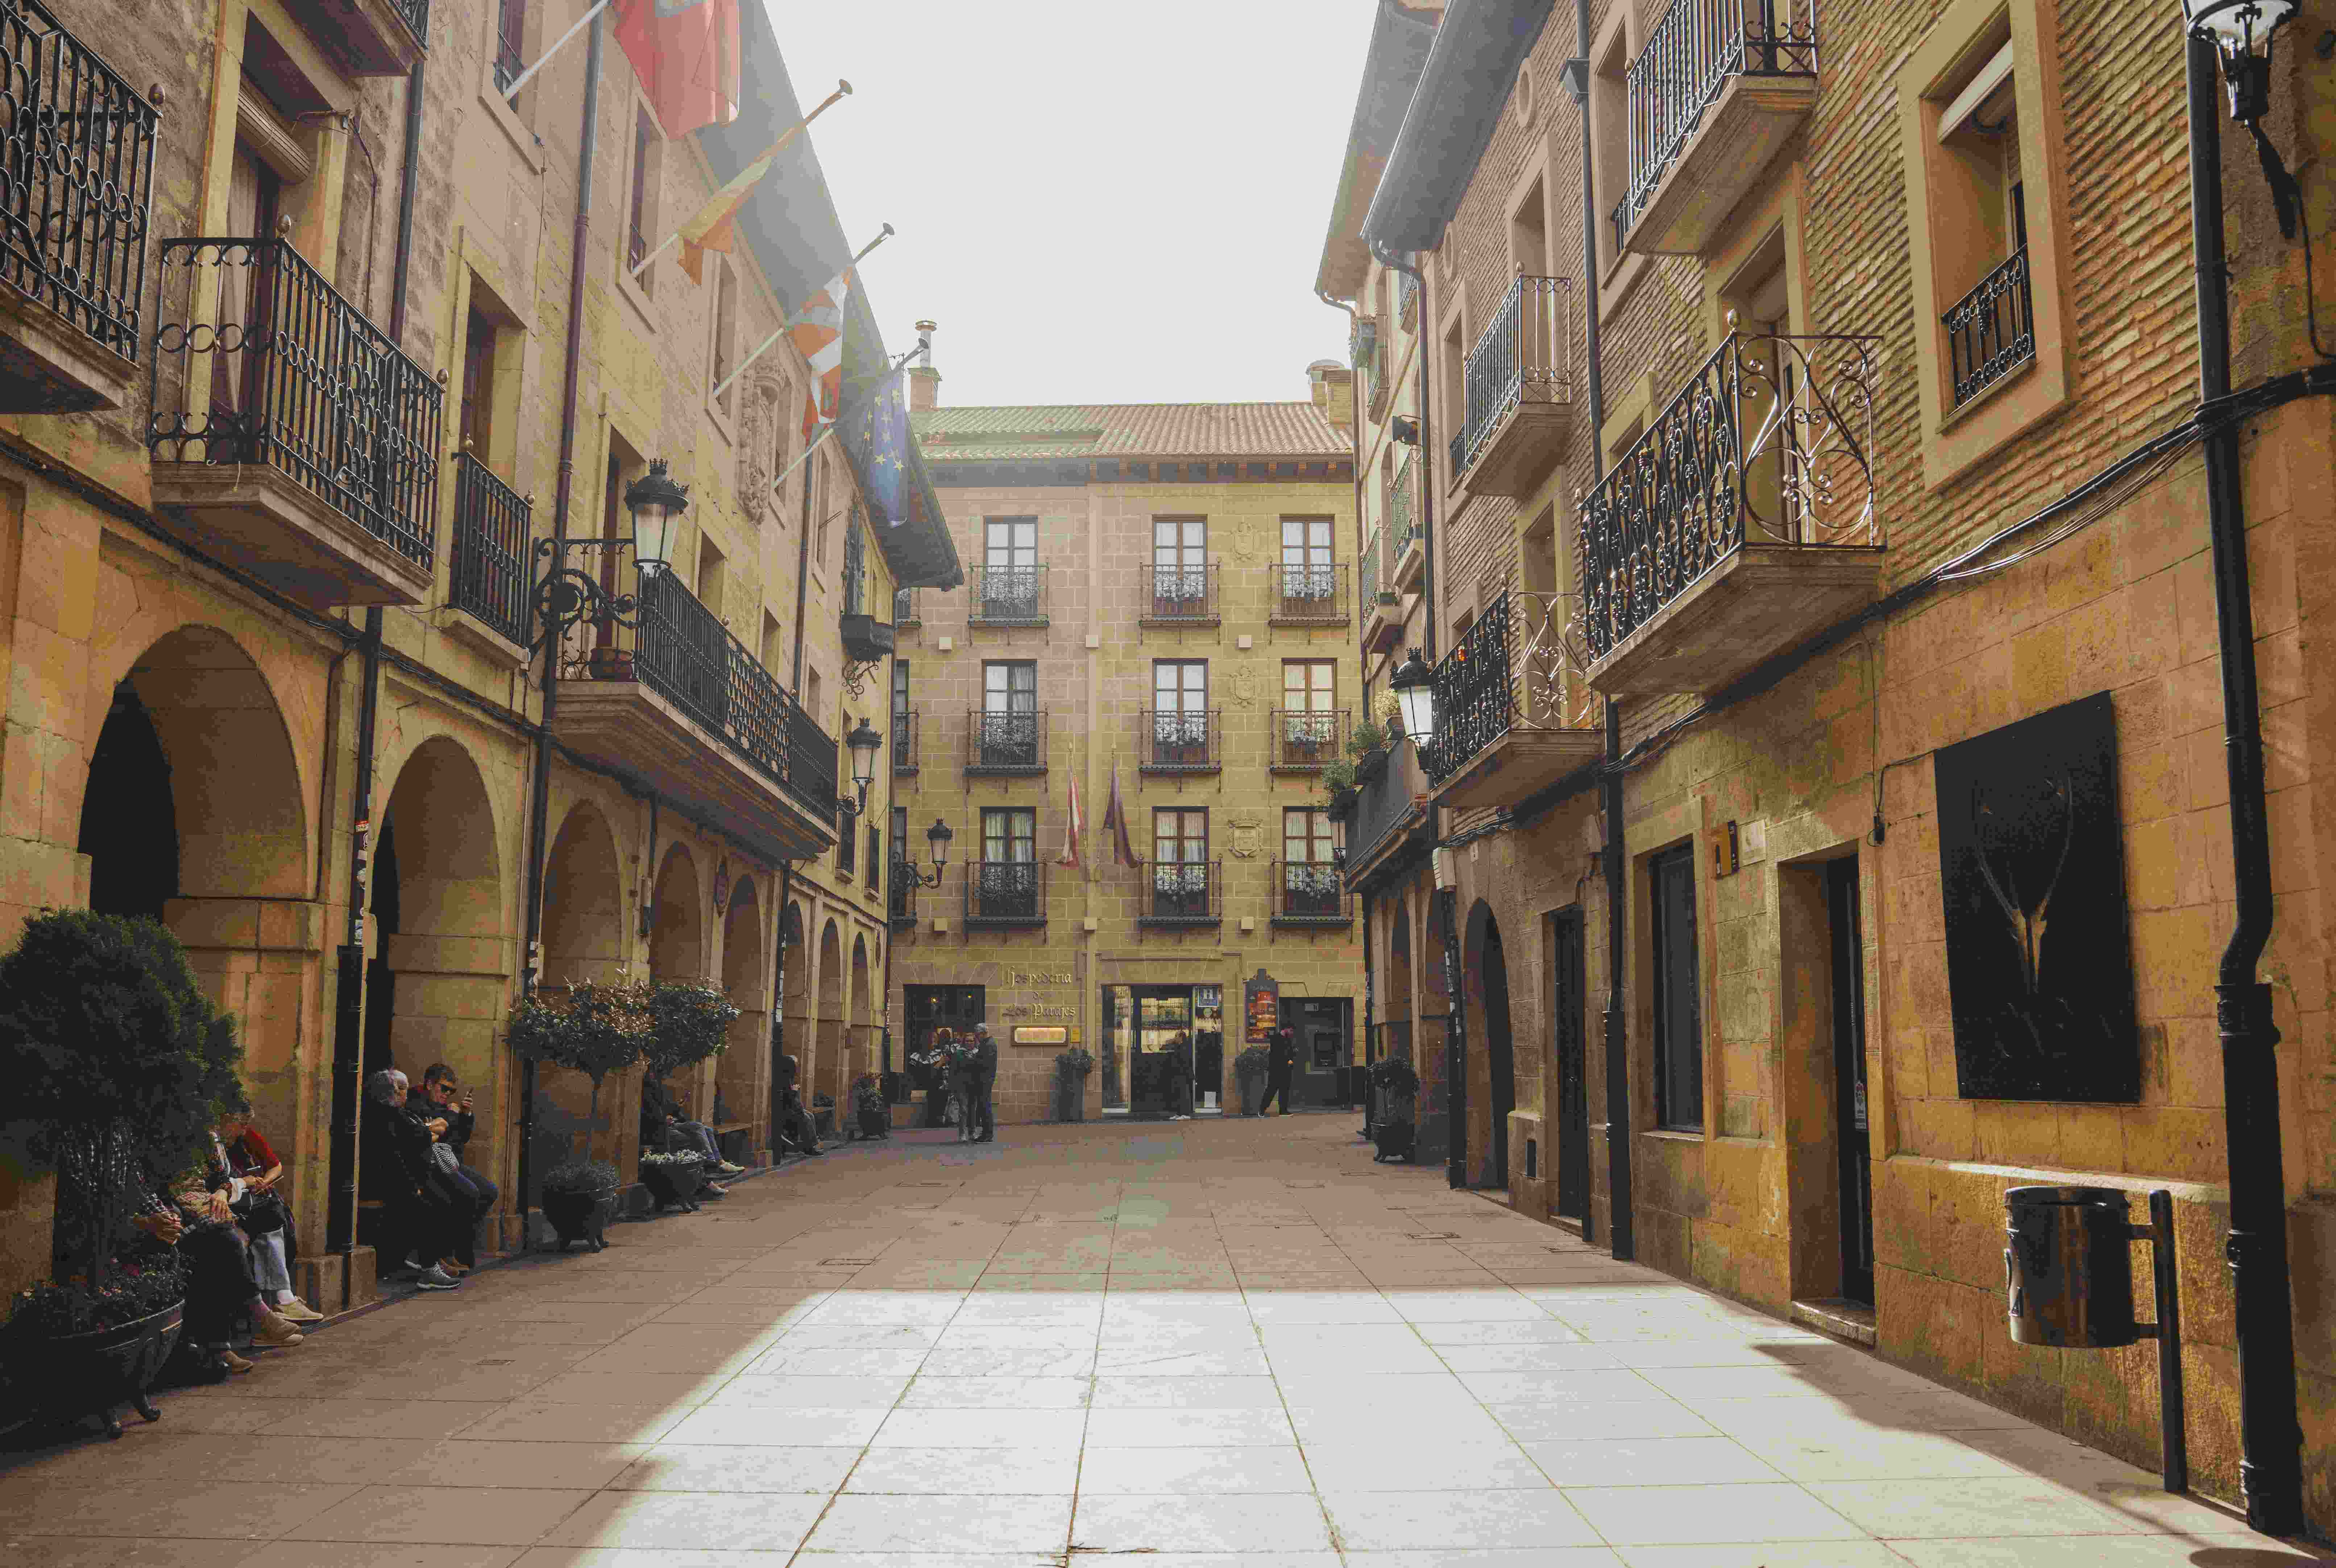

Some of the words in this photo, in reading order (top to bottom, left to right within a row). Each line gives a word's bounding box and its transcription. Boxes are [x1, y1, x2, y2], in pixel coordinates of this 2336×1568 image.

[1032, 991, 1044, 1000] de
[1203, 989, 1213, 999] H
[1002, 1003, 1027, 1017] Los
[1032, 1003, 1076, 1020] Parajes
